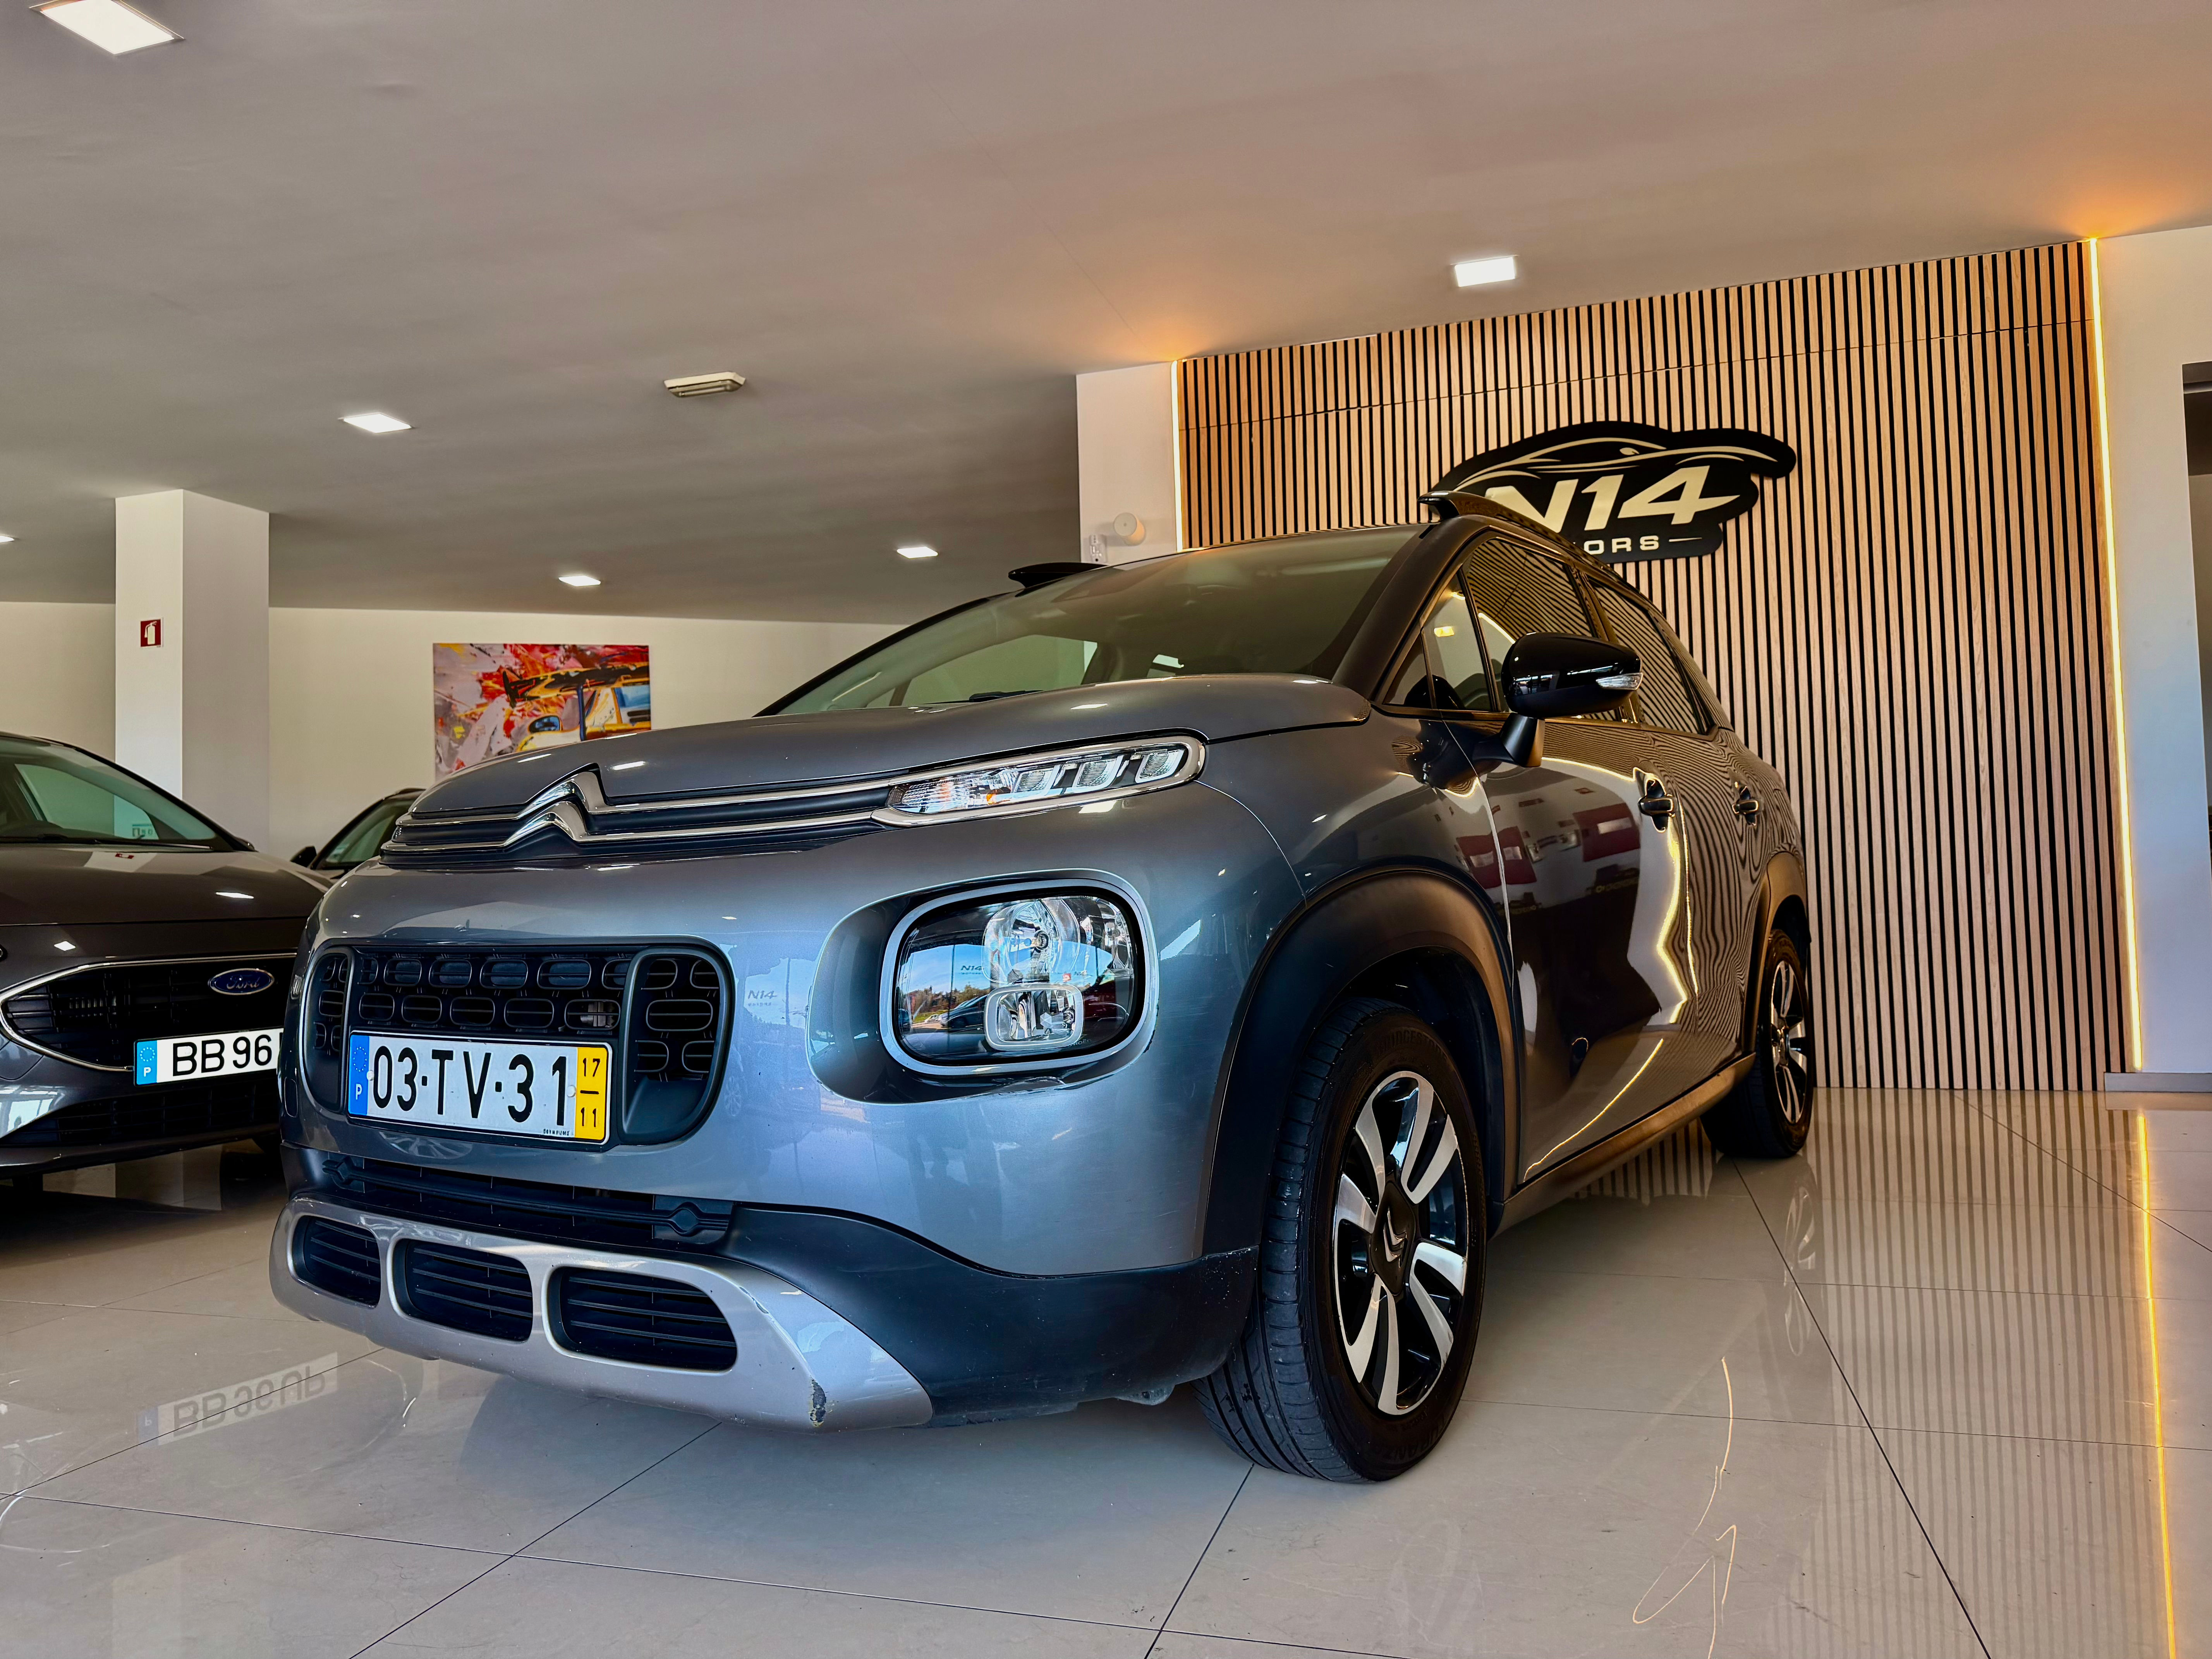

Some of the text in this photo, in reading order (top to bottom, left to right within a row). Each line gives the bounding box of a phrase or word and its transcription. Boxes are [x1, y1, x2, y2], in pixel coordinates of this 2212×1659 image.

[1485, 465, 1740, 533] N14
[1575, 535, 1659, 555] ORS
[173, 1039, 225, 1077] BB
[233, 1034, 272, 1068] 96
[143, 1067, 151, 1077] P
[583, 1058, 601, 1077] 17
[356, 1084, 362, 1100] P
[580, 1107, 597, 1127] 11
